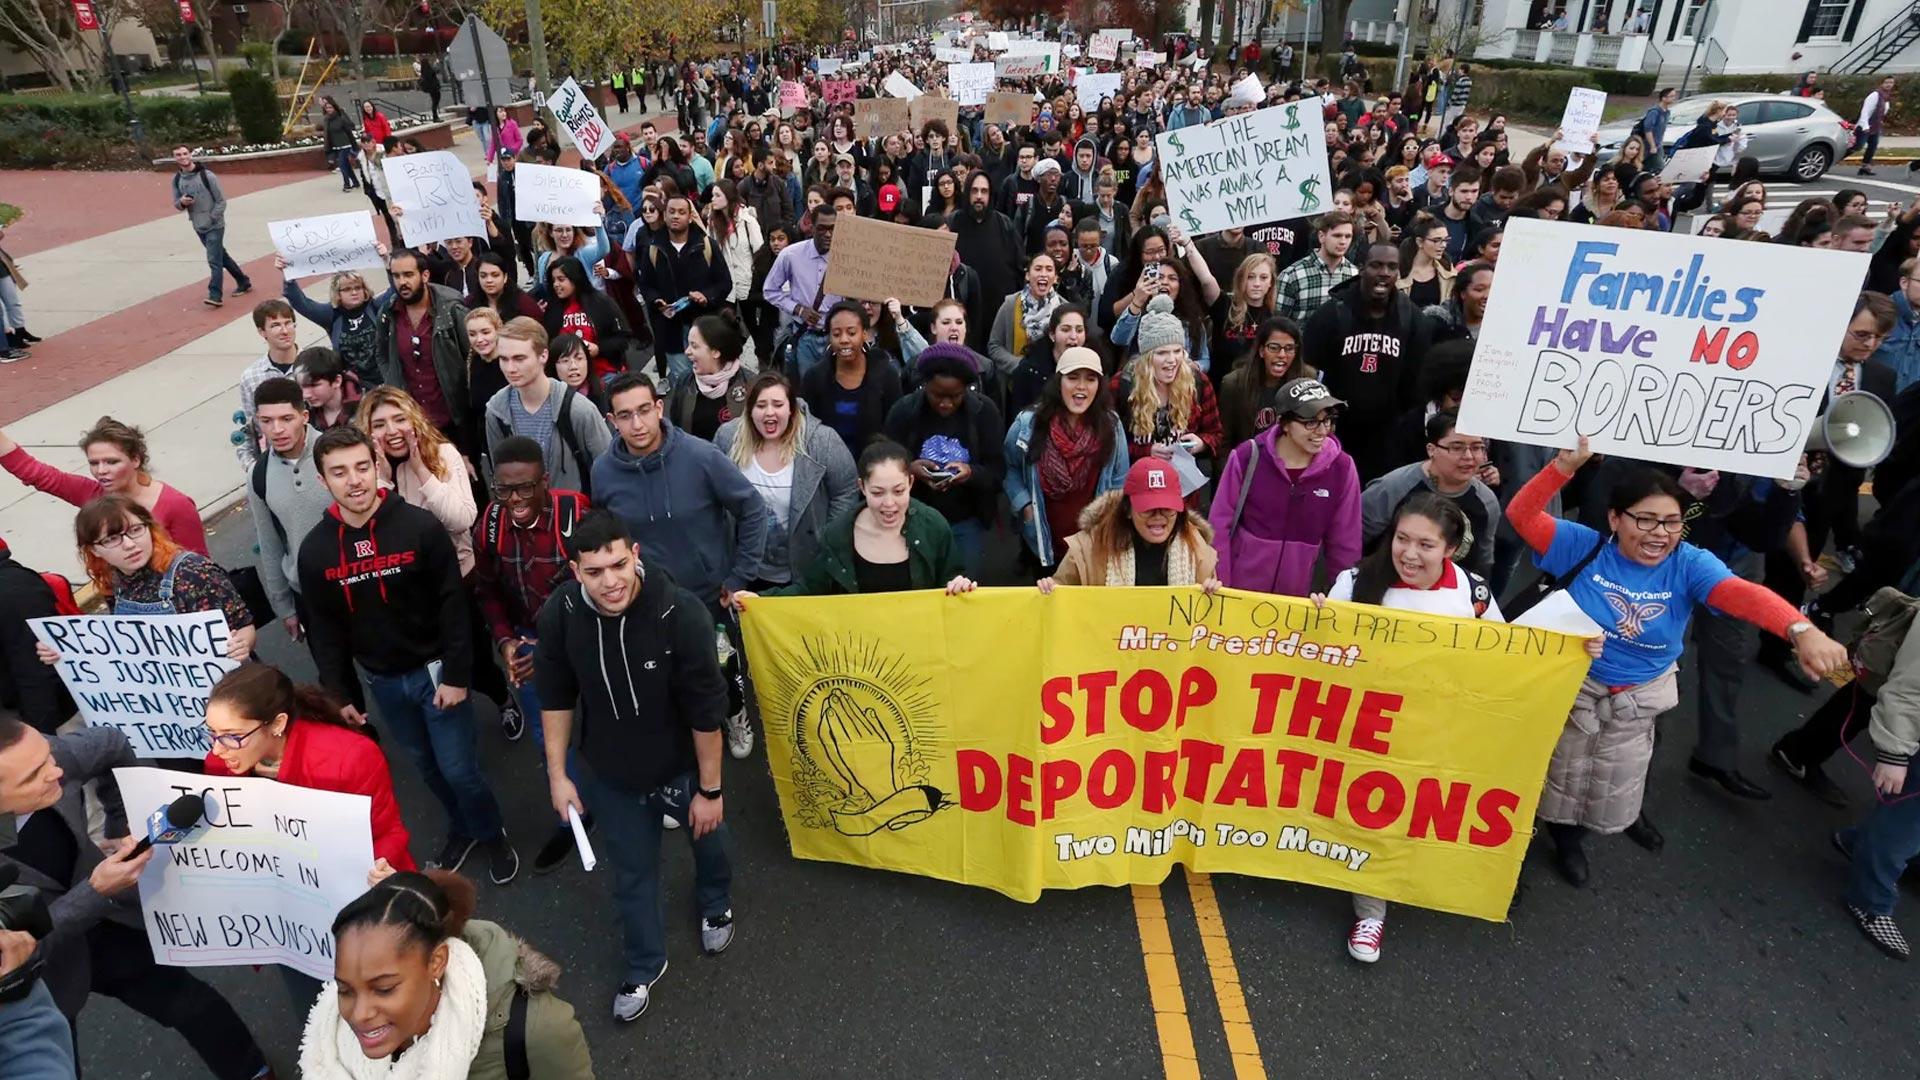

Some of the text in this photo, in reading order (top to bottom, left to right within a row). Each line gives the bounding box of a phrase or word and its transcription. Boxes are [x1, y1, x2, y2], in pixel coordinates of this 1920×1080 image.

[556, 87, 577, 123] Equal
[566, 103, 595, 134] RIGHTS
[1212, 114, 1259, 146] THE
[1165, 133, 1311, 185] AMERICAN DREAM
[885, 194, 894, 202] R
[1180, 164, 1292, 204] WAS ALWAYS A
[1225, 194, 1268, 225] MYTH
[280, 222, 345, 252] Love
[308, 247, 339, 265] ONE
[1560, 241, 1766, 323] Families
[1341, 332, 1401, 358] RUTGERS
[1527, 306, 1760, 371] Have NO
[1360, 353, 1378, 373] R
[1516, 350, 1816, 455] BORDERS
[490, 503, 501, 543] MAX AIR
[325, 550, 416, 580] RUTGERS
[354, 540, 375, 558] R
[1169, 592, 1242, 626] NOT
[1251, 600, 1342, 633] OUR
[42, 618, 228, 658] RESISTANCE
[1118, 624, 1361, 668] Mr. President
[64, 660, 226, 689] IS JUSTIFIED
[79, 692, 164, 714] WHEN
[1040, 666, 1404, 755] STOP THE
[956, 739, 1521, 848] DEPORTATIONS
[273, 814, 308, 841] NOT
[1054, 831, 1117, 862] Two
[1216, 823, 1269, 847] Too
[1277, 825, 1372, 872] Many
[169, 845, 320, 889] WELCOME IN
[154, 910, 208, 948] NEW
